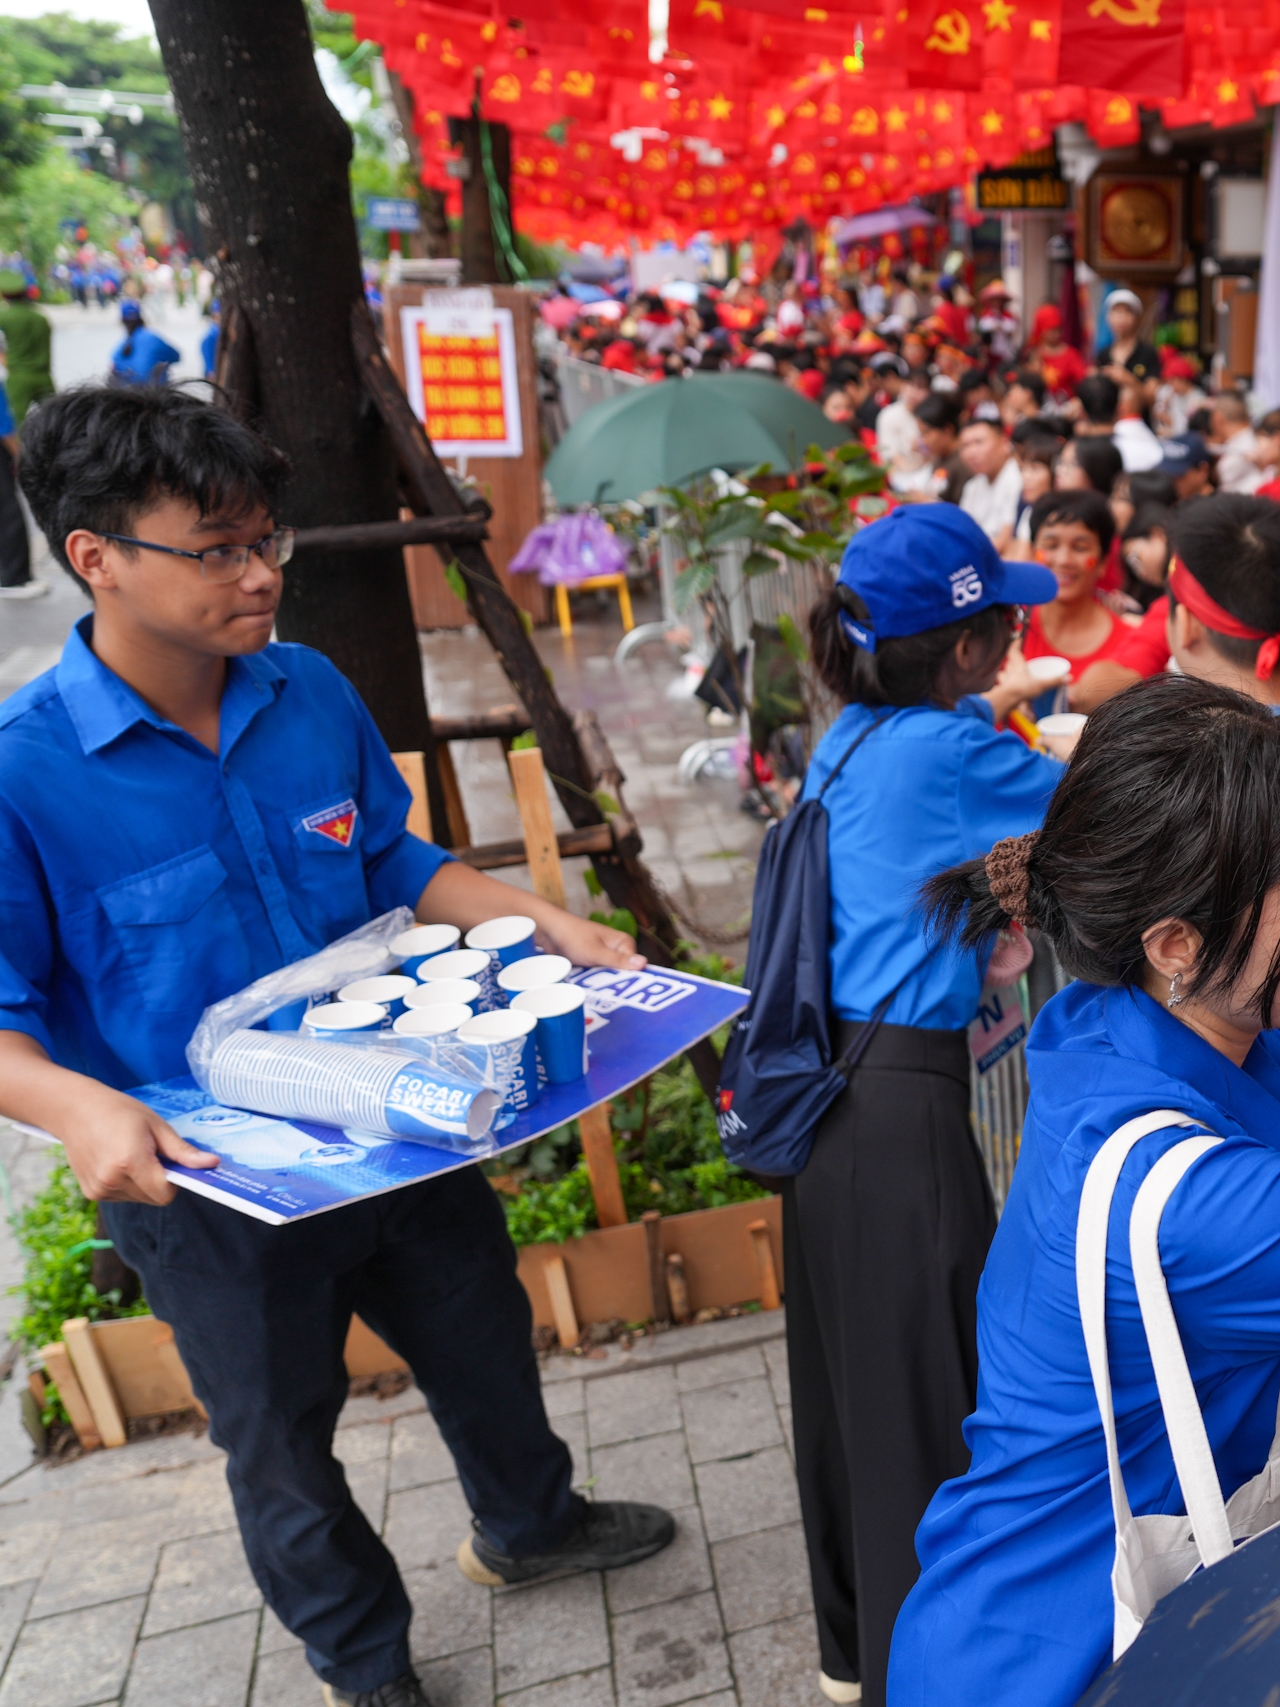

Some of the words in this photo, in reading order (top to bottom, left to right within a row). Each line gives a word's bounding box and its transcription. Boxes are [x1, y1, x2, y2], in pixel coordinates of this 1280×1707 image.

[951, 573, 983, 608] 5G
[388, 1087, 460, 1117] SWEAT
[394, 1074, 472, 1106] POCARI
